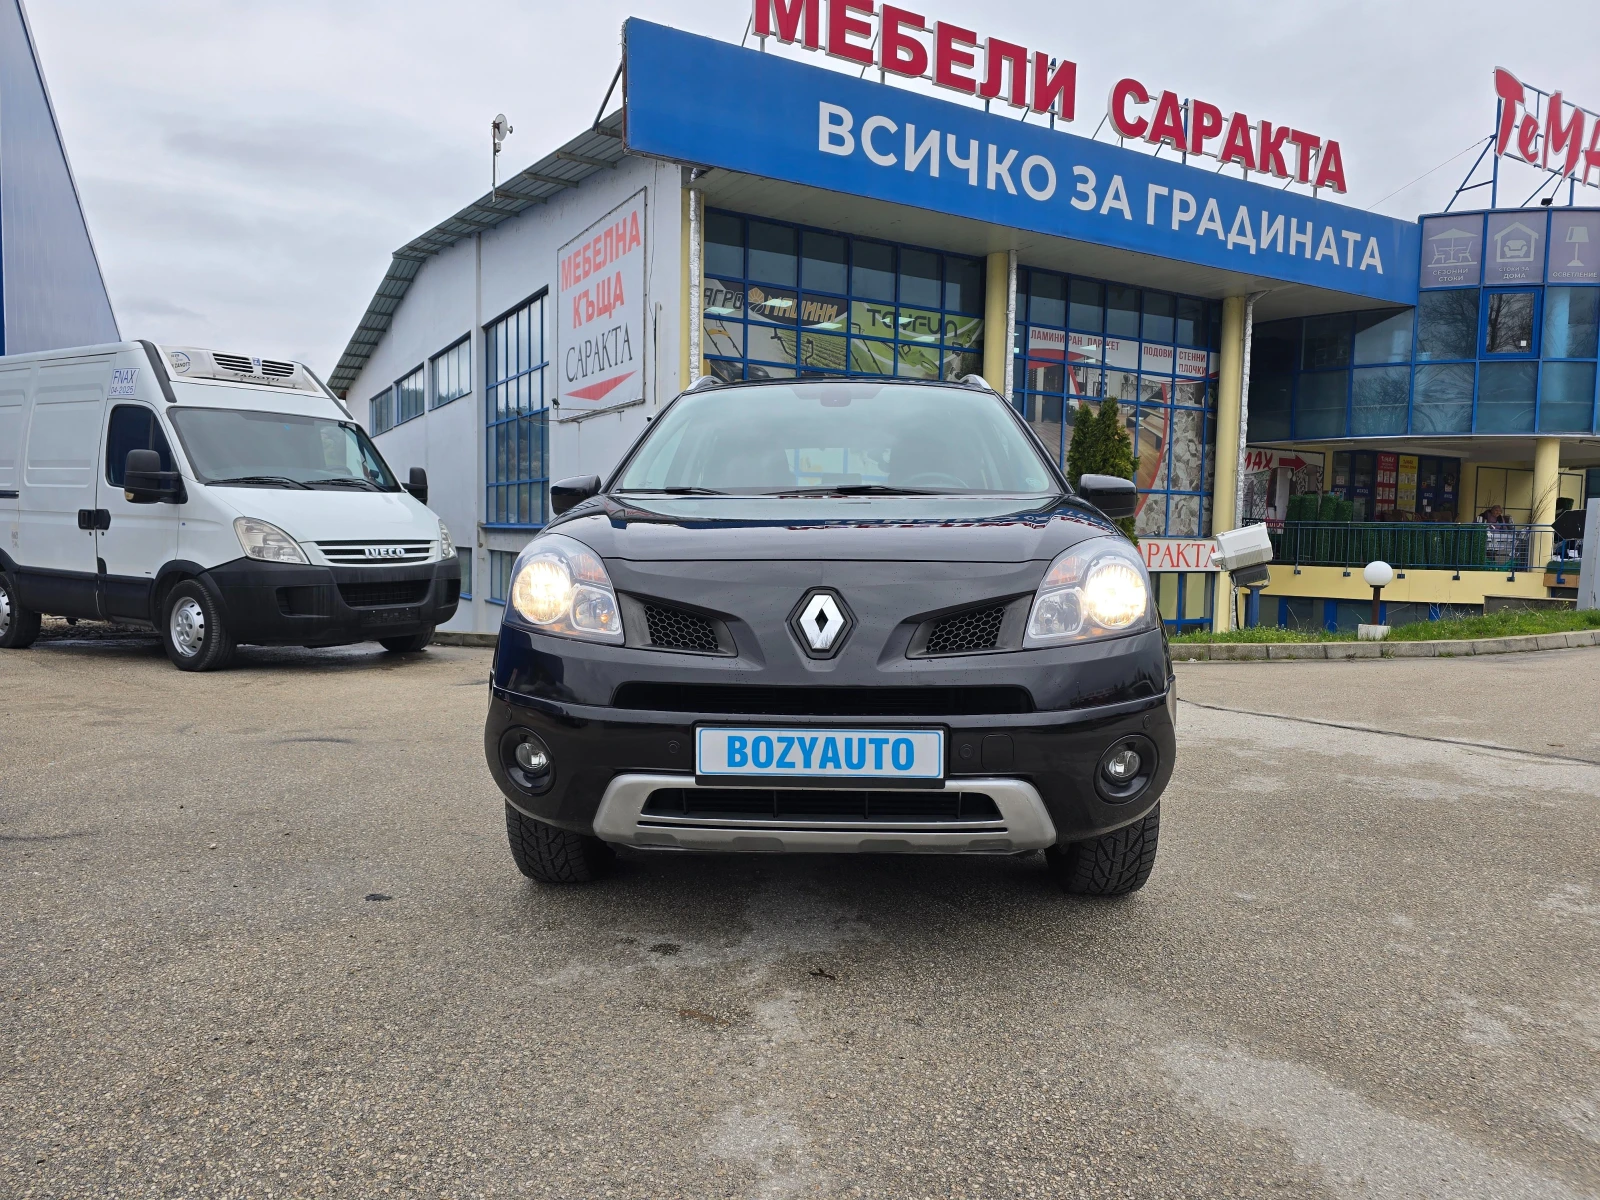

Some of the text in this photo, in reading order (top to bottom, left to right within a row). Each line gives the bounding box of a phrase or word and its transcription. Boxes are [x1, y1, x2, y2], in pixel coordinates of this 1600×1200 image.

[751, 0, 1347, 194] МЕБЕЛИ САРАКТА
[818, 101, 1384, 275] ВСИЧКО ЗА ГРАДИНАТА
[561, 210, 641, 292] МЕБЕЛНА
[1552, 271, 1598, 279] ОСВЕТЛЕНИЕ
[573, 270, 625, 329] КЪЩА
[565, 322, 633, 383] САРАКТА
[1030, 329, 1083, 347] ЛАМИНИРАН
[1143, 345, 1206, 363] ПОДОВИ СТЕННИ
[1178, 363, 1206, 376] ПЛОЧКИ
[365, 548, 405, 558] IVECO
[727, 736, 915, 771] BOZYAUTO
